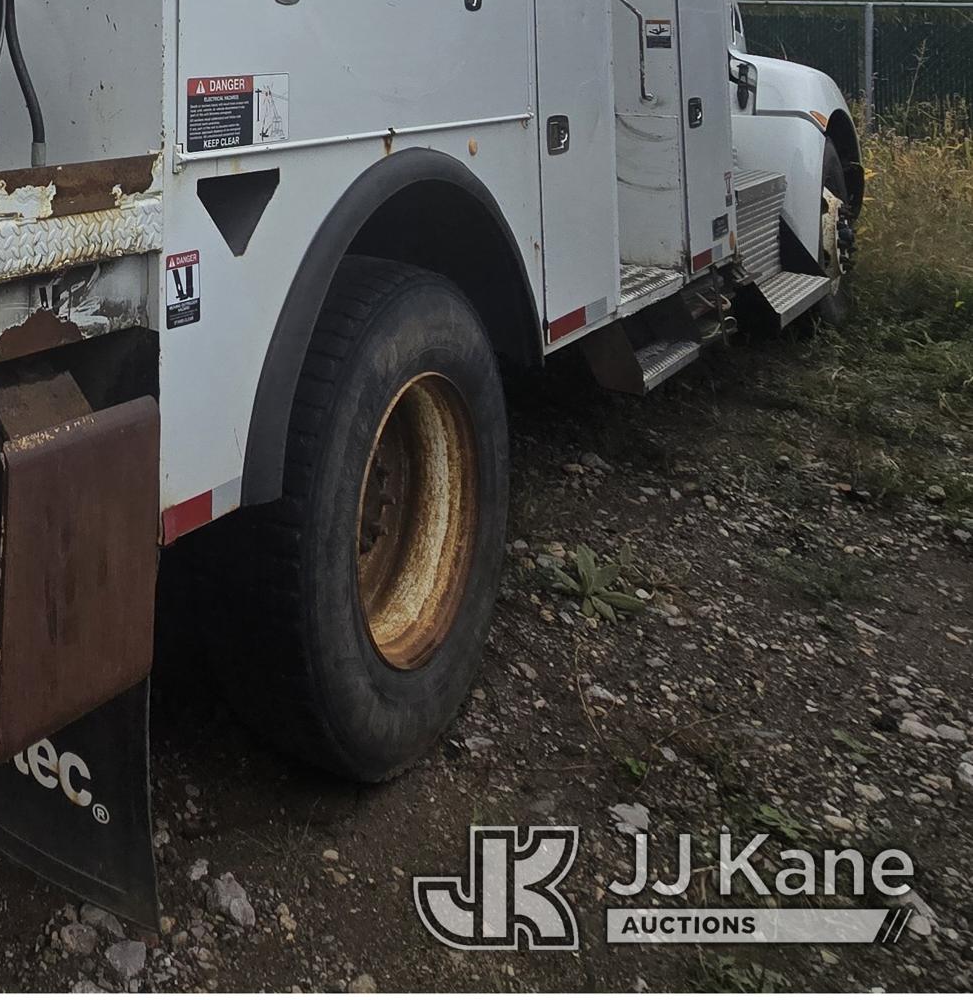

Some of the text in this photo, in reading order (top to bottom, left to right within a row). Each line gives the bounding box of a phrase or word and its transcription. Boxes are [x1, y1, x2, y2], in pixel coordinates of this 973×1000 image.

[209, 78, 245, 92] DANGER
[203, 136, 240, 149] KEEP CLEAR
[175, 253, 197, 265] DANGER
